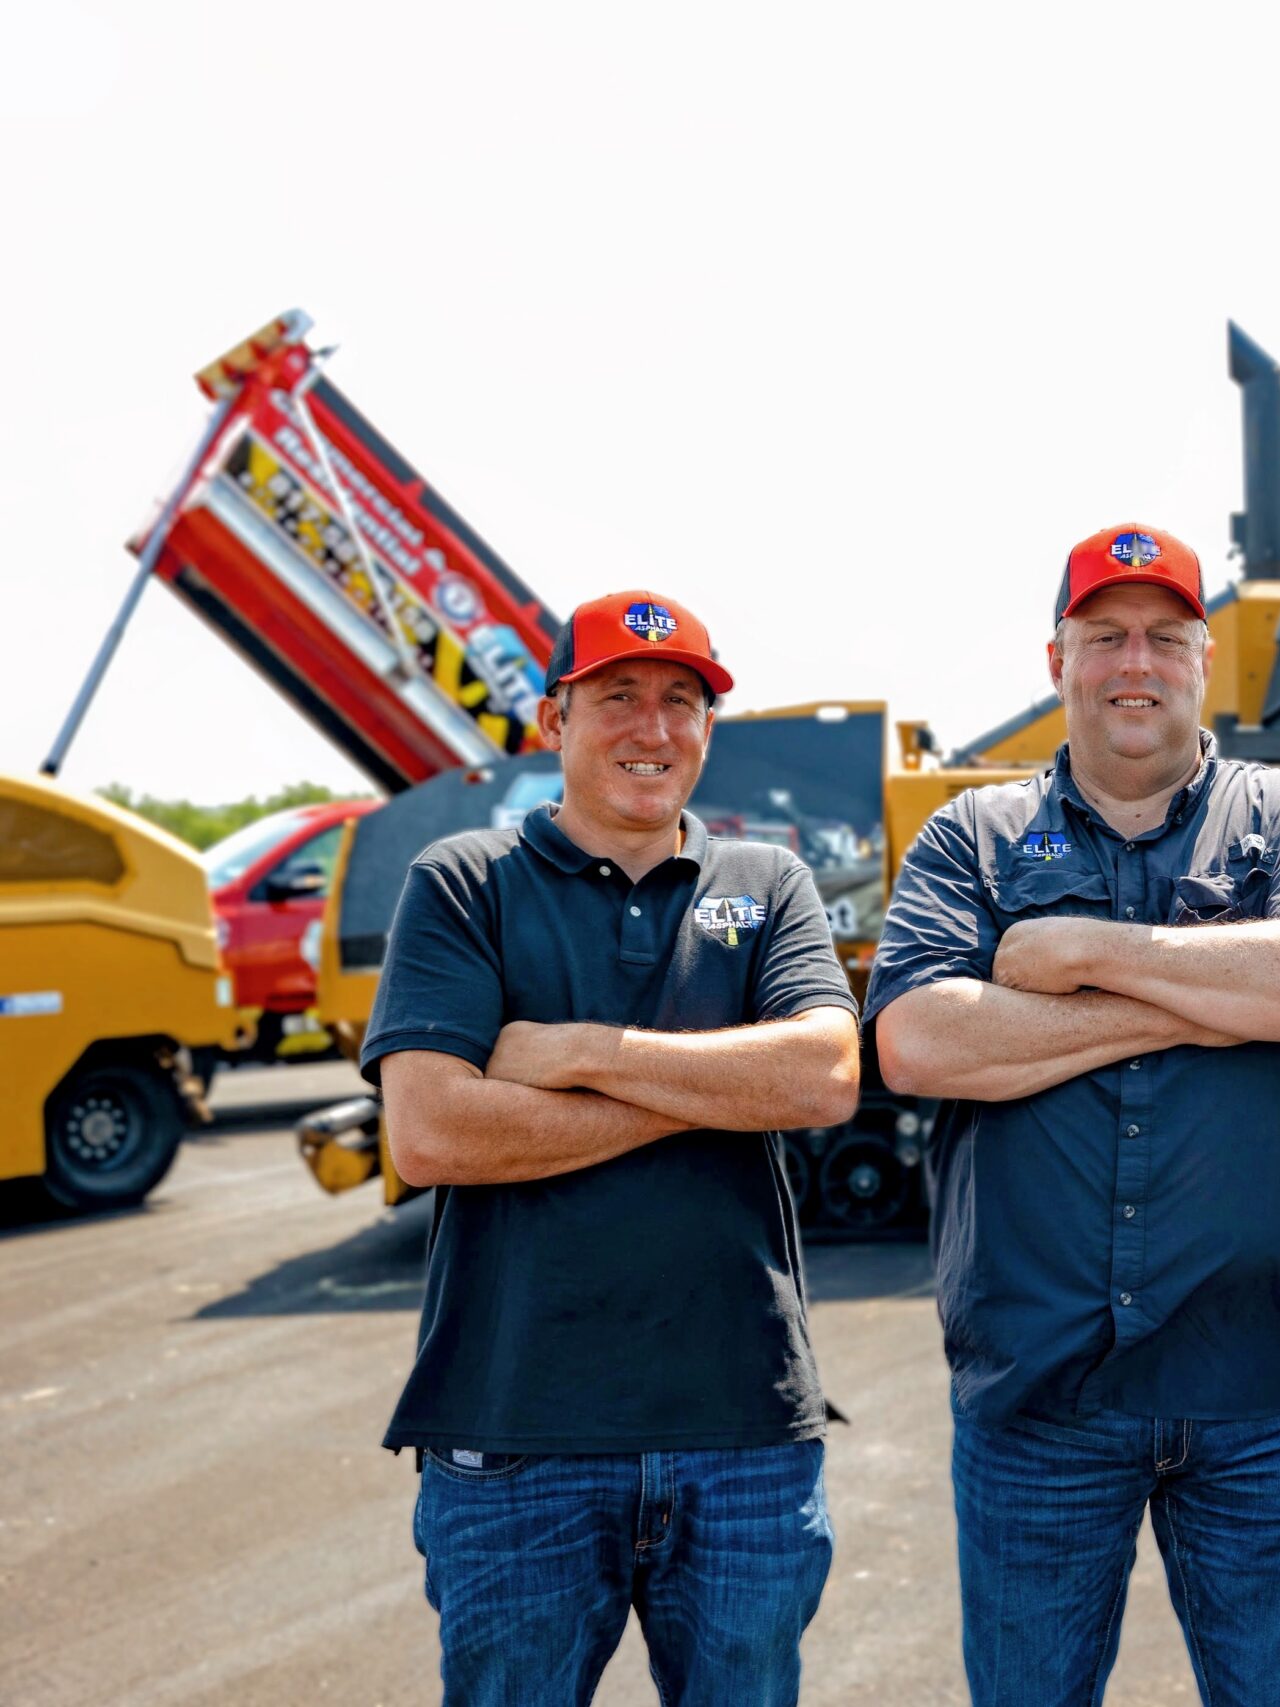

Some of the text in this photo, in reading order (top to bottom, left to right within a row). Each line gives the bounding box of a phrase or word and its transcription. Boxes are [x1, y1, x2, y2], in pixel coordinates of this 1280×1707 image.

[624, 614, 677, 630] ELITE
[1023, 844, 1071, 853] ELITE
[694, 905, 766, 922] ELITE
[708, 921, 753, 930] ASPHALT
